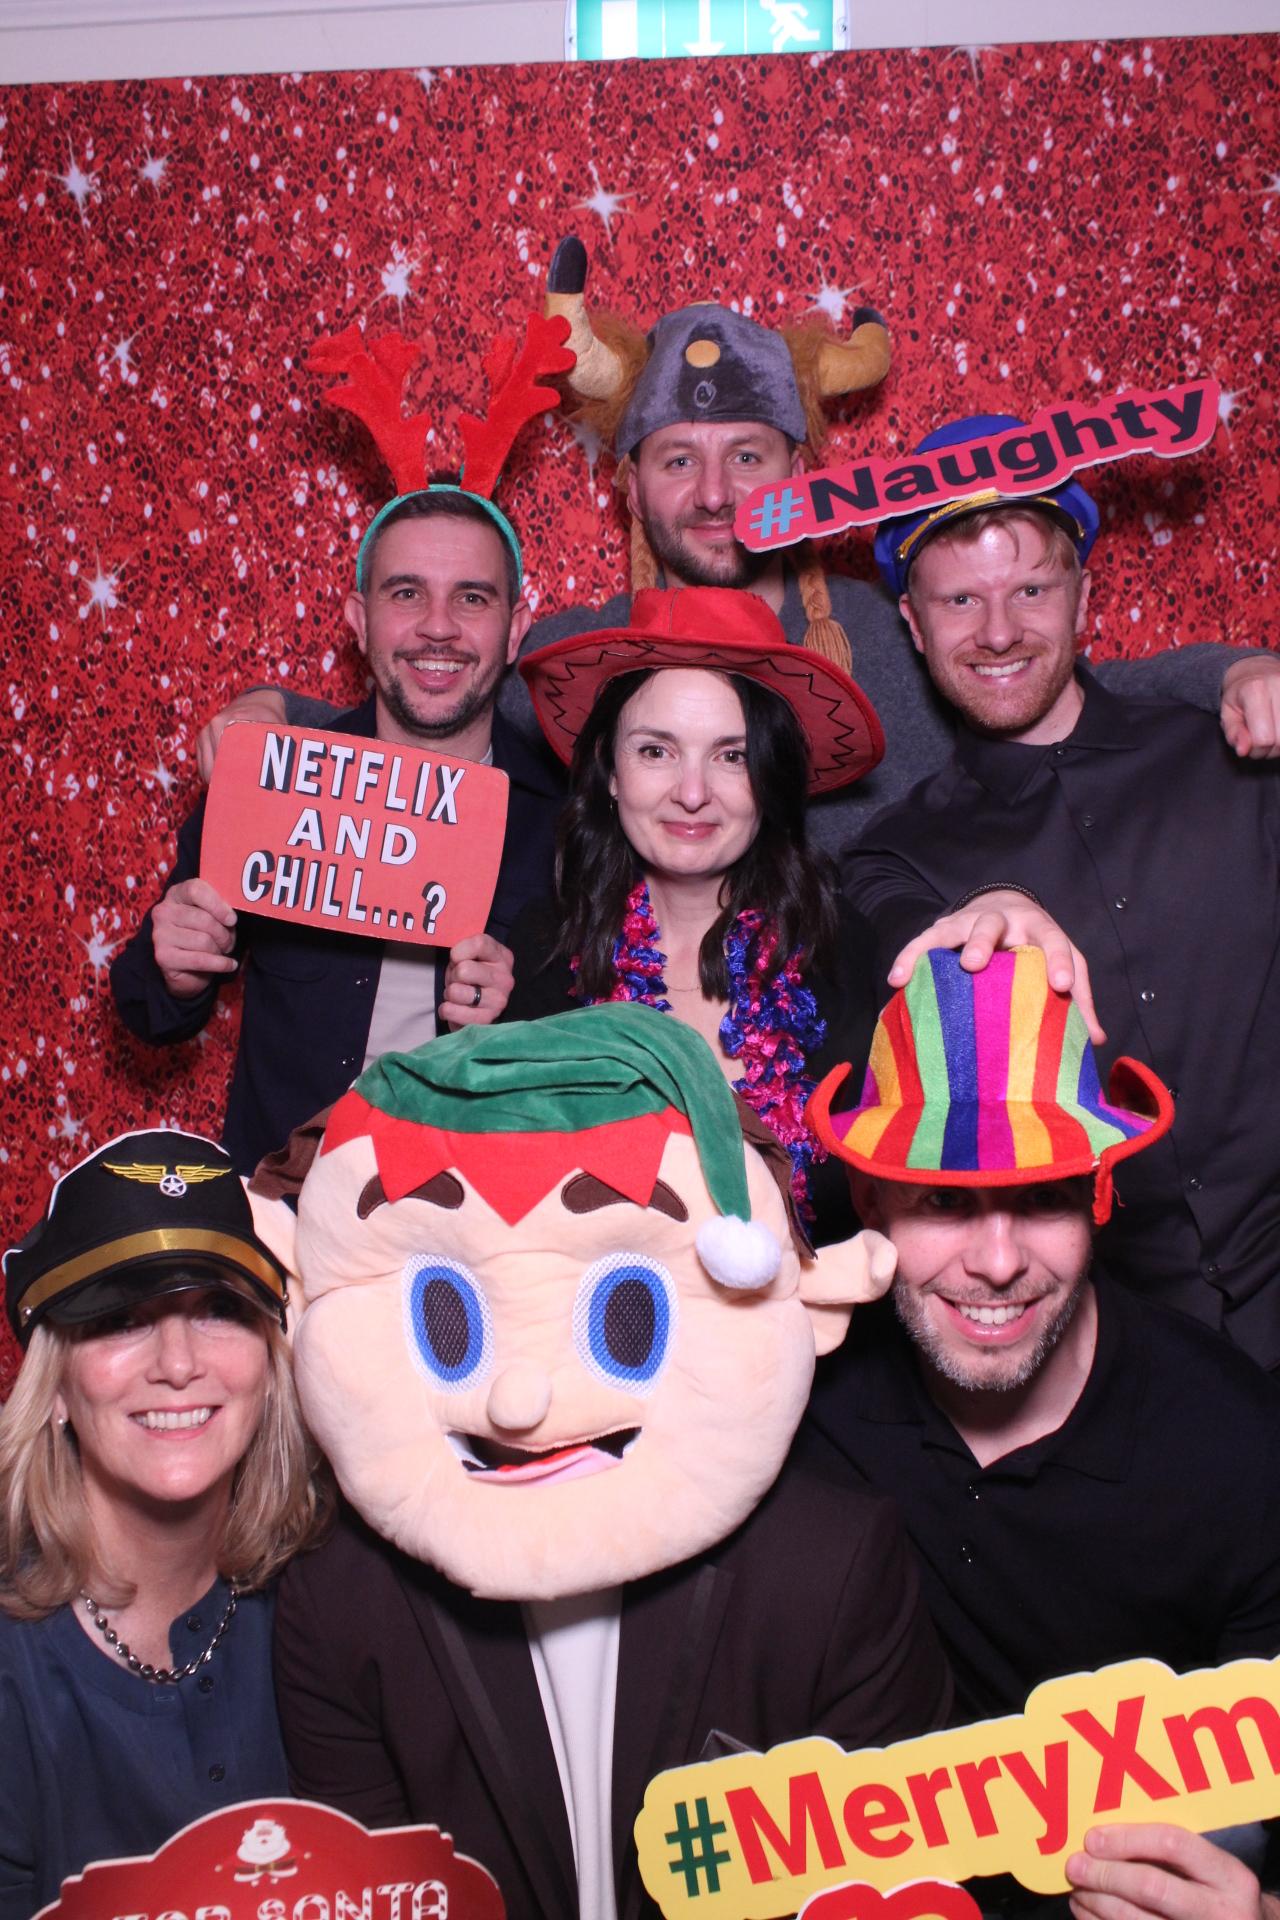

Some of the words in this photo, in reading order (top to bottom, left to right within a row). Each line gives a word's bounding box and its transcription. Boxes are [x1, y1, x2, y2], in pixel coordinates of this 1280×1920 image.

[749, 388, 1204, 539] #Naughty
[258, 731, 466, 825] NETFLIX
[286, 807, 417, 865] AND
[241, 850, 447, 935] CHILL...?
